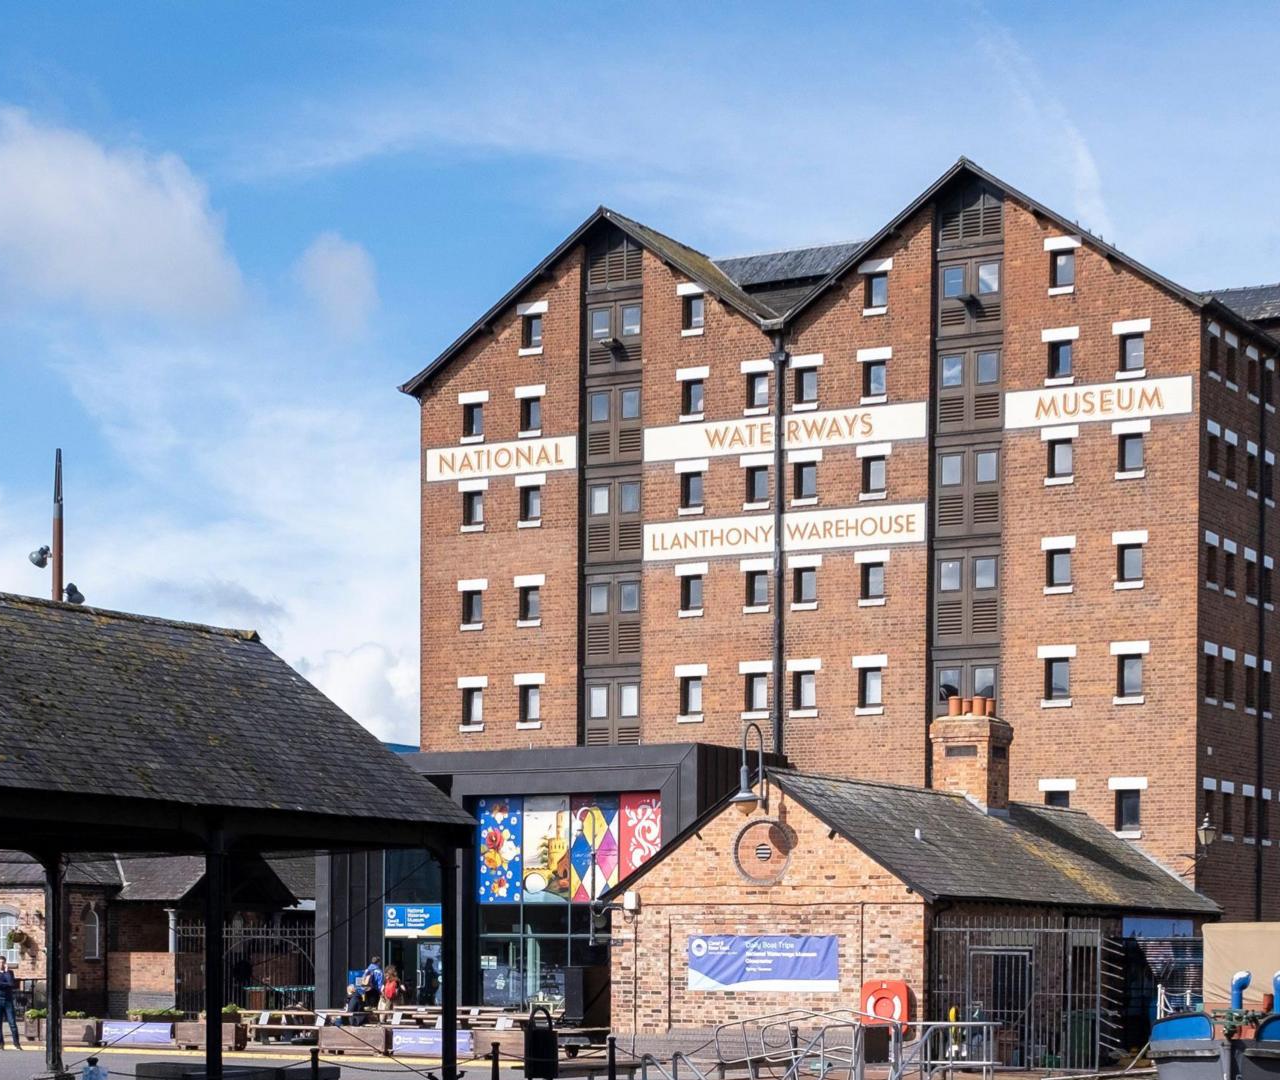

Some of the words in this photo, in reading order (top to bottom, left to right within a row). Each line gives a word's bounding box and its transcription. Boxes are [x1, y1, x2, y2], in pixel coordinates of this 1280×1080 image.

[439, 443, 564, 473] NATIONAL
[705, 413, 873, 449] WATERWAYS
[1035, 387, 1164, 420] MUSEUM
[651, 524, 773, 551] LLANTHONY
[786, 513, 917, 540] WAREHOUSE
